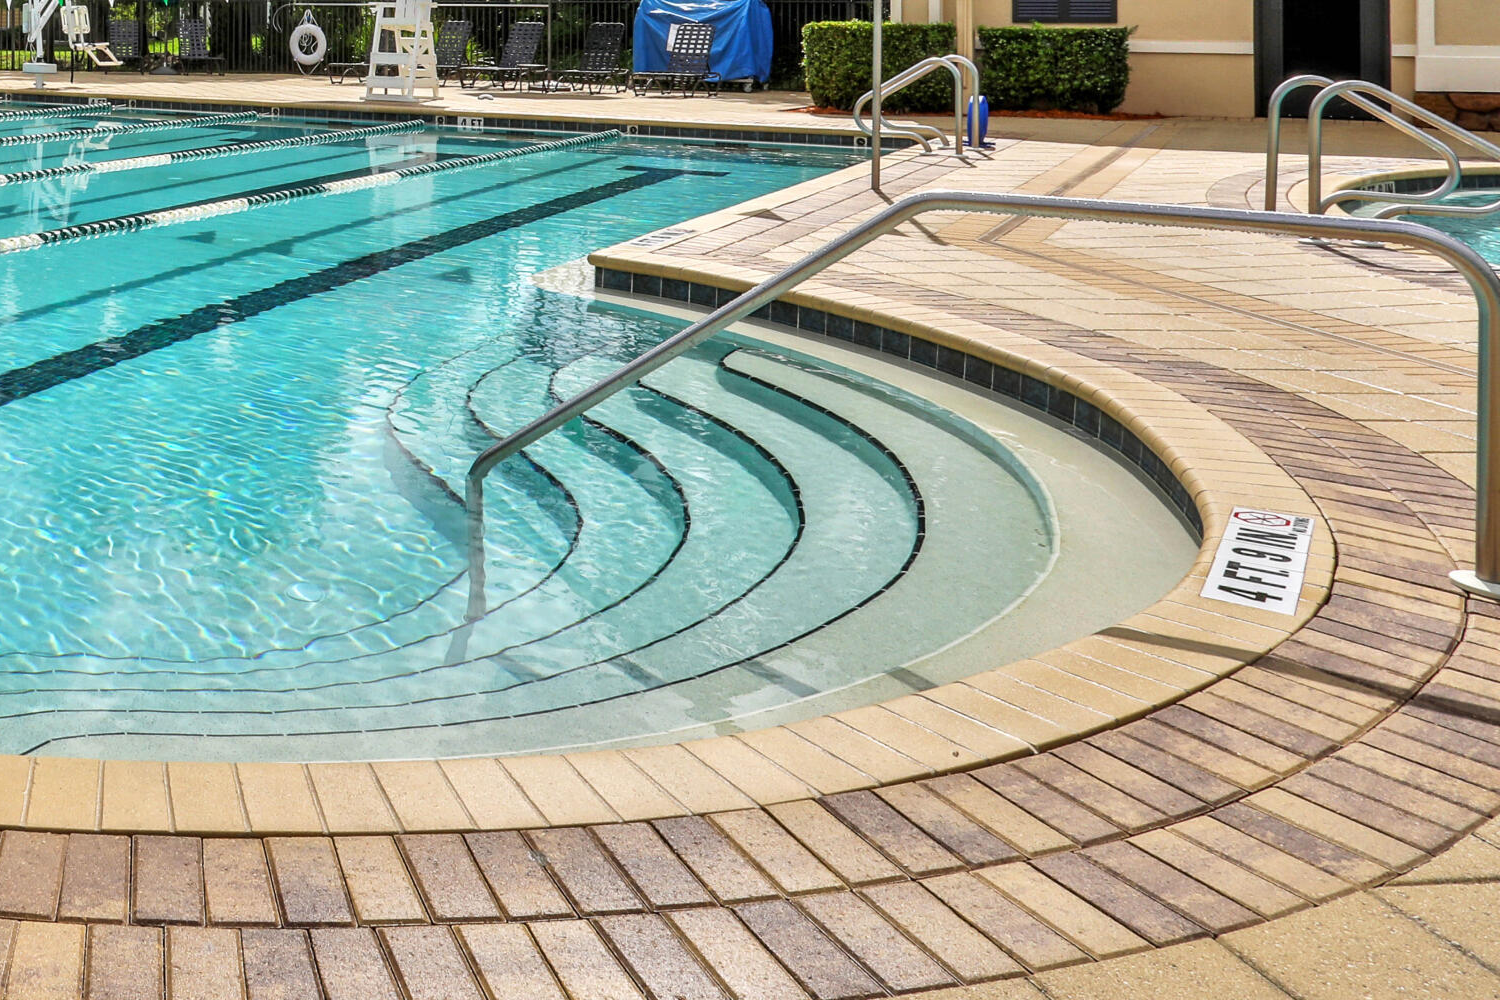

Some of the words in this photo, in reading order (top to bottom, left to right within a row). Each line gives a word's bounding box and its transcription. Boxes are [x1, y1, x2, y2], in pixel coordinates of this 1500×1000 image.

[470, 118, 483, 127] FT
[1231, 547, 1293, 563] 9
[1217, 585, 1283, 603] 4
